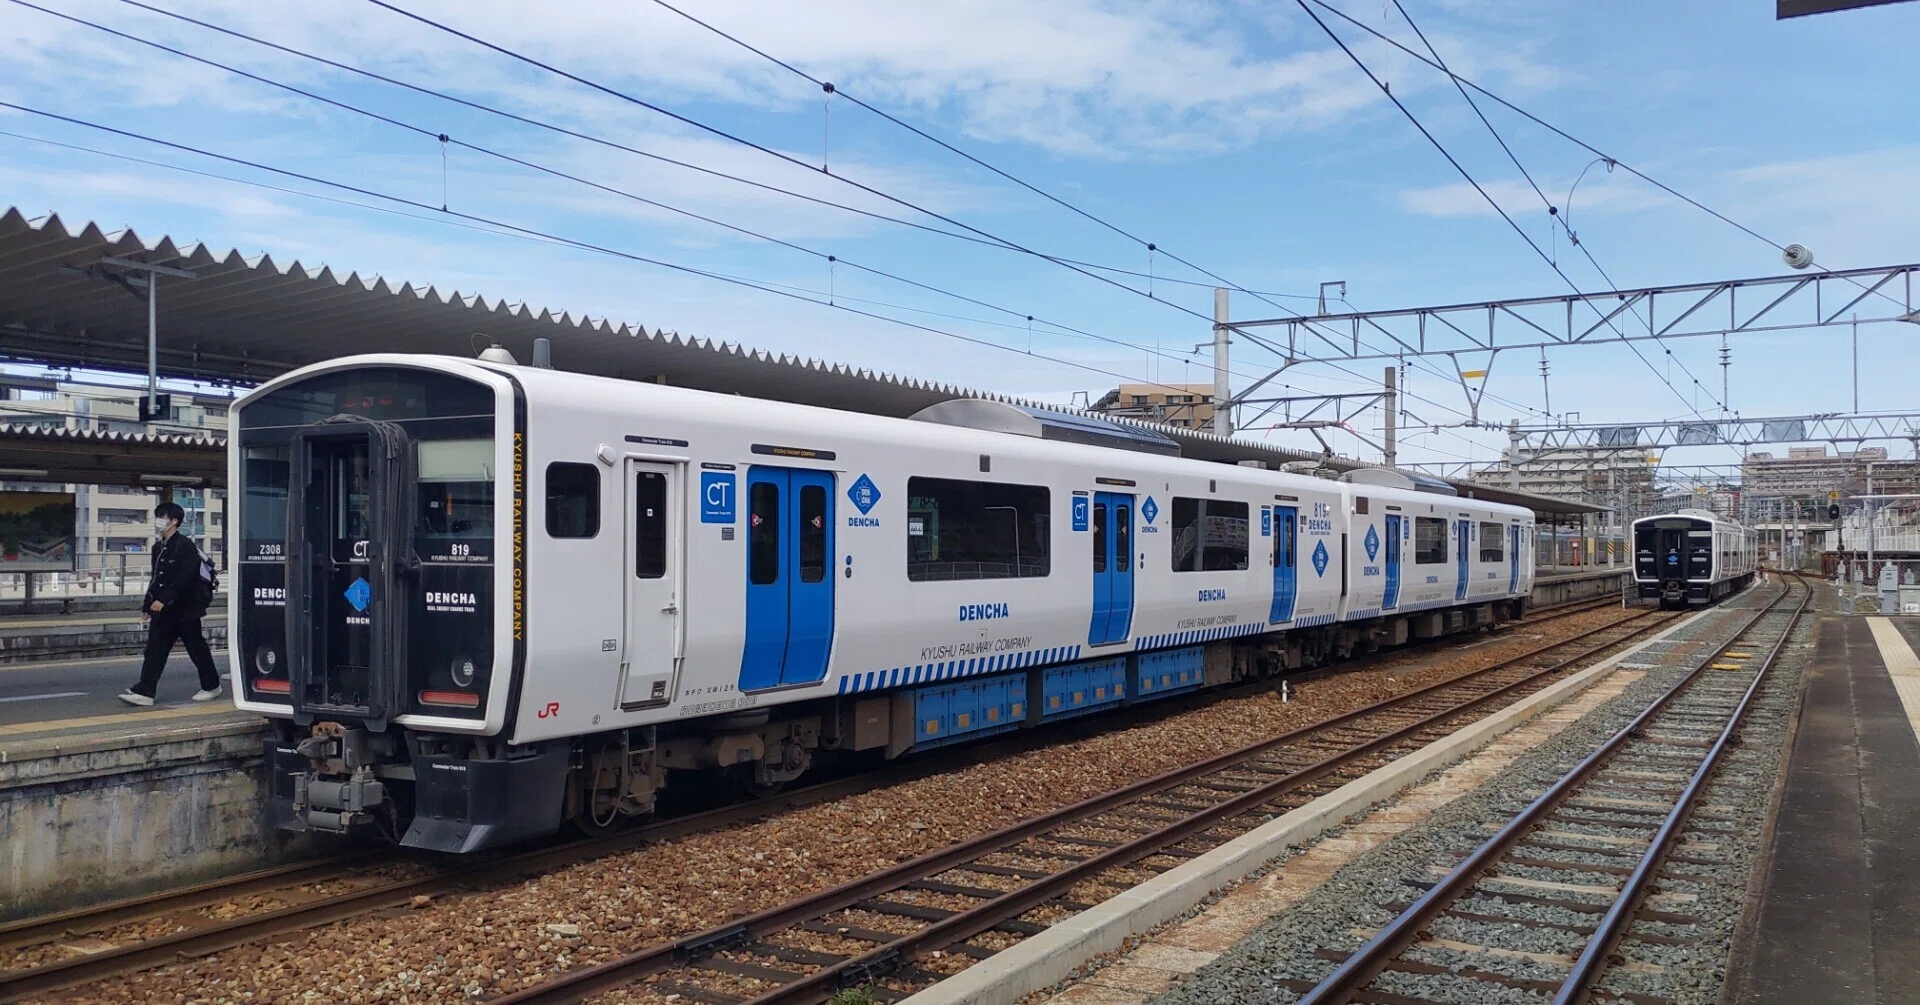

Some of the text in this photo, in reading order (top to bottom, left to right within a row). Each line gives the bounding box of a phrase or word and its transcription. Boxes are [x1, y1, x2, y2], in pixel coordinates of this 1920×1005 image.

[706, 482, 730, 508] CT
[1074, 503, 1086, 521] CT
[848, 517, 880, 528] DENCHA
[1308, 519, 1332, 530] DENCHA
[513, 432, 522, 641] KYUSHU RAILWAY COMPANY
[259, 544, 281, 555] Z308
[353, 540, 370, 557] CT
[451, 543, 470, 556] 819
[425, 591, 476, 605] DENCHA
[1198, 588, 1226, 602] DENCHA
[959, 602, 1009, 622] DENCHA
[1176, 617, 1197, 630] KYUSHU
[920, 636, 1032, 661] KYUSHU RAILWAY COMPANY
[537, 702, 560, 719] JR
